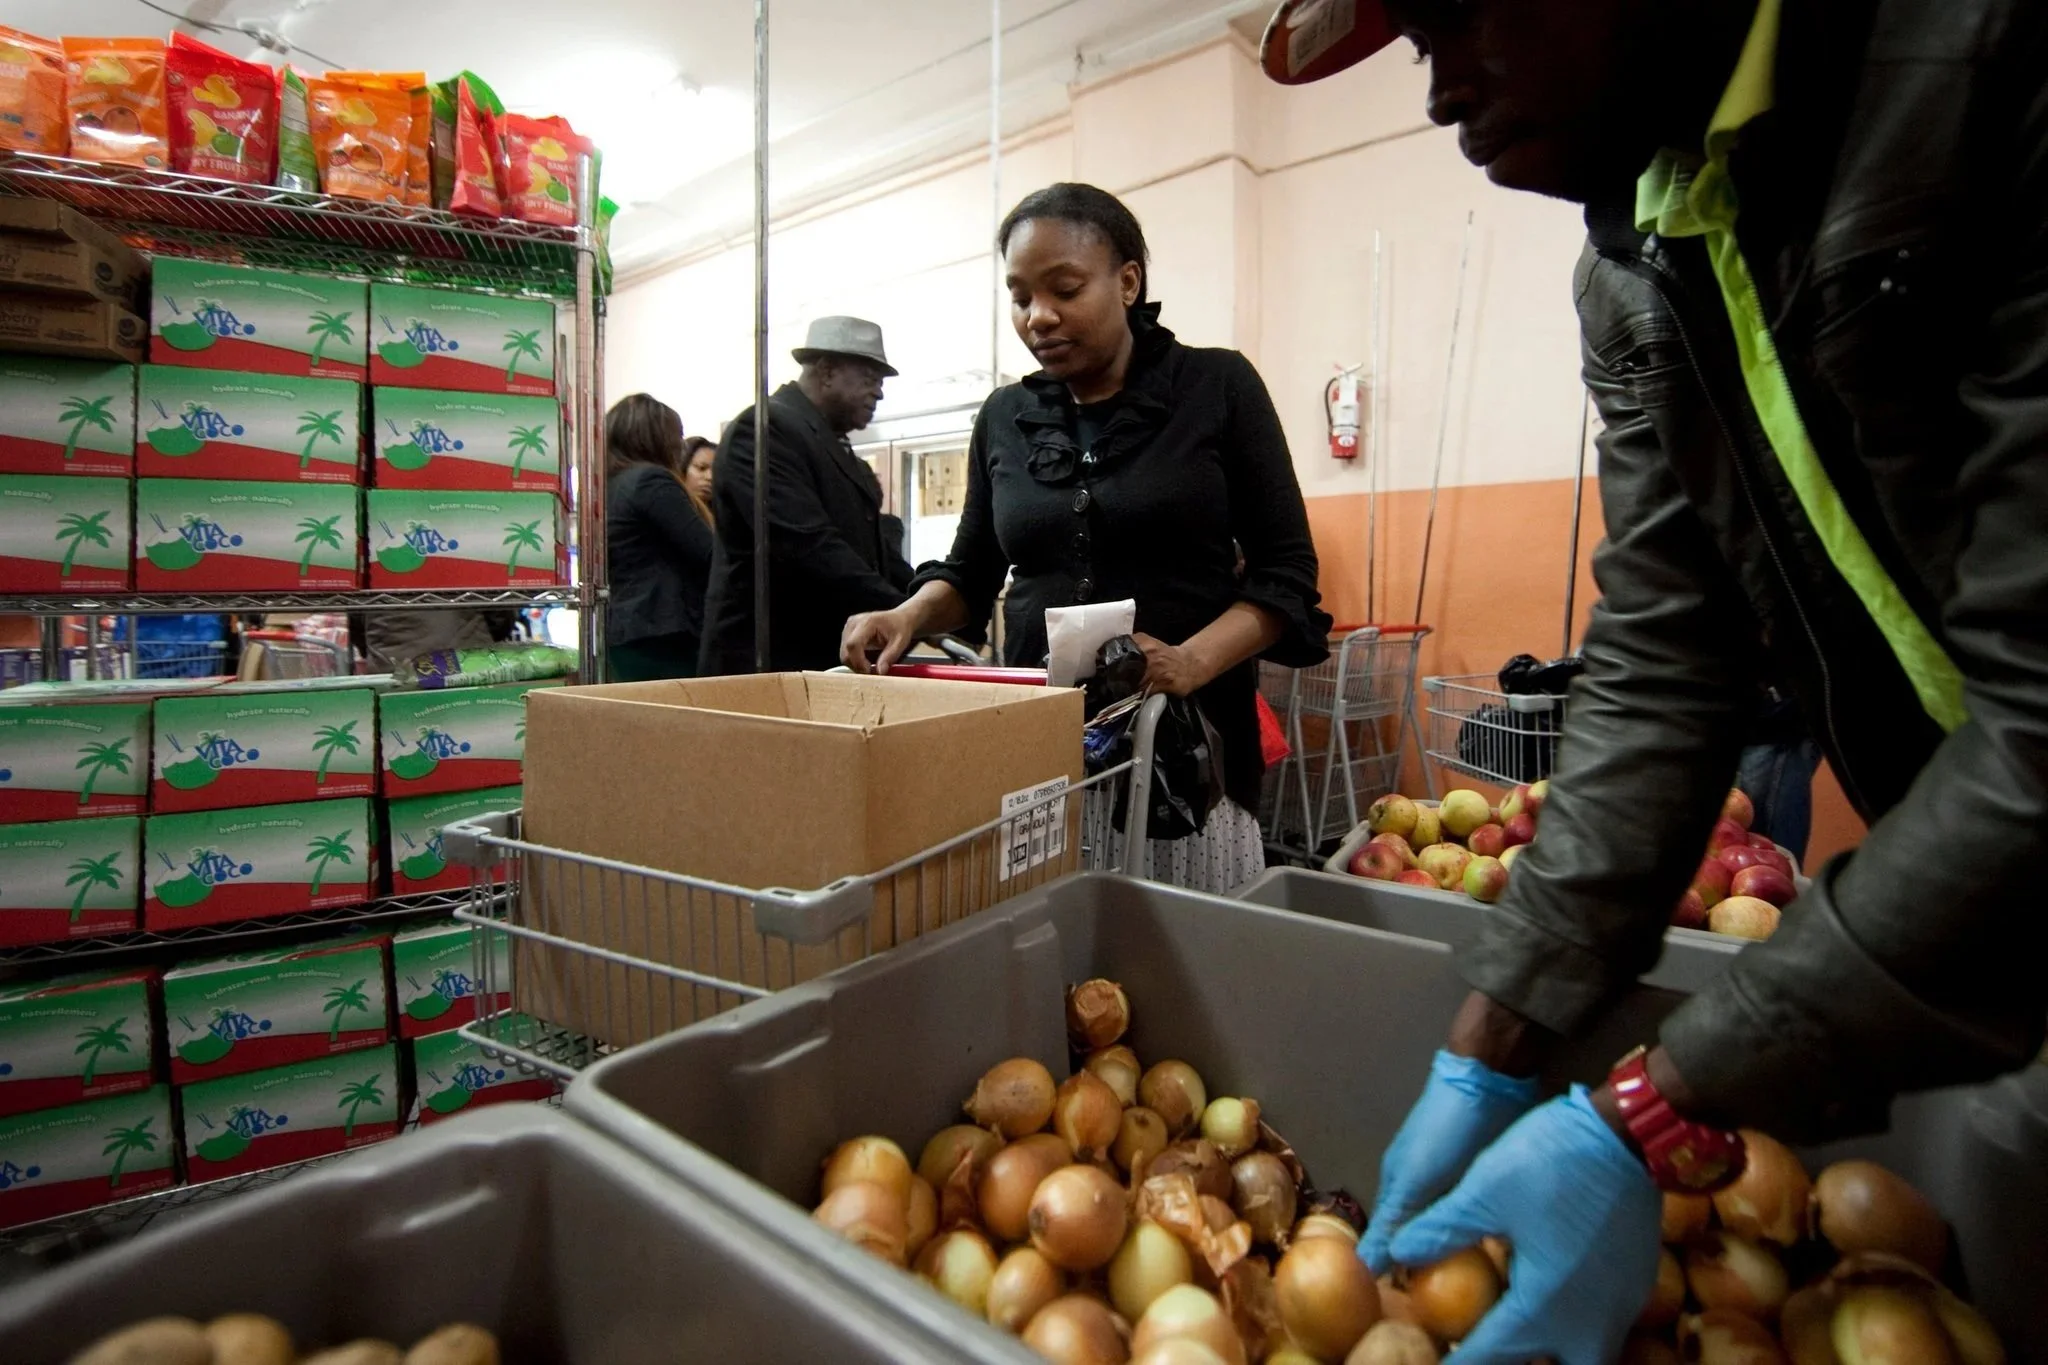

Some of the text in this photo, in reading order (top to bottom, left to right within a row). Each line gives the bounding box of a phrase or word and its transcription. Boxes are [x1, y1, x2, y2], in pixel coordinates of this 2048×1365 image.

[193, 308, 241, 326] VITA
[207, 323, 256, 336] COCO
[405, 328, 445, 344] VITA
[416, 340, 459, 352] COCO
[212, 385, 296, 399] hydrate naturally
[180, 411, 230, 430] VITA
[194, 424, 244, 439] COCO
[409, 428, 451, 445] VITA
[422, 440, 464, 454] COCO
[210, 495, 293, 507] hydrate naturally
[429, 503, 500, 513] hydrate naturally
[179, 522, 229, 541] VITA
[404, 528, 446, 546] VITA
[194, 534, 243, 551] COCO
[416, 539, 459, 554] COCO
[226, 706, 312, 719] hydrate naturally
[414, 700, 471, 718] hydratez-vous
[195, 738, 245, 758] VITA
[416, 733, 458, 752] VITA
[429, 742, 471, 760] COCO
[209, 749, 260, 768] COCO
[219, 819, 304, 834] hydrate naturally
[14, 839, 65, 849] naturally
[188, 853, 237, 876] VITA
[202, 863, 253, 885] COCO
[431, 973, 472, 994] VITA
[20, 1008, 97, 1018] naturellement
[208, 1012, 257, 1035] VITA
[223, 1019, 272, 1041] COCO
[452, 1065, 493, 1085] VITA
[465, 1069, 505, 1092] COCO
[226, 1109, 276, 1131] VITA
[240, 1114, 288, 1138] COCO
